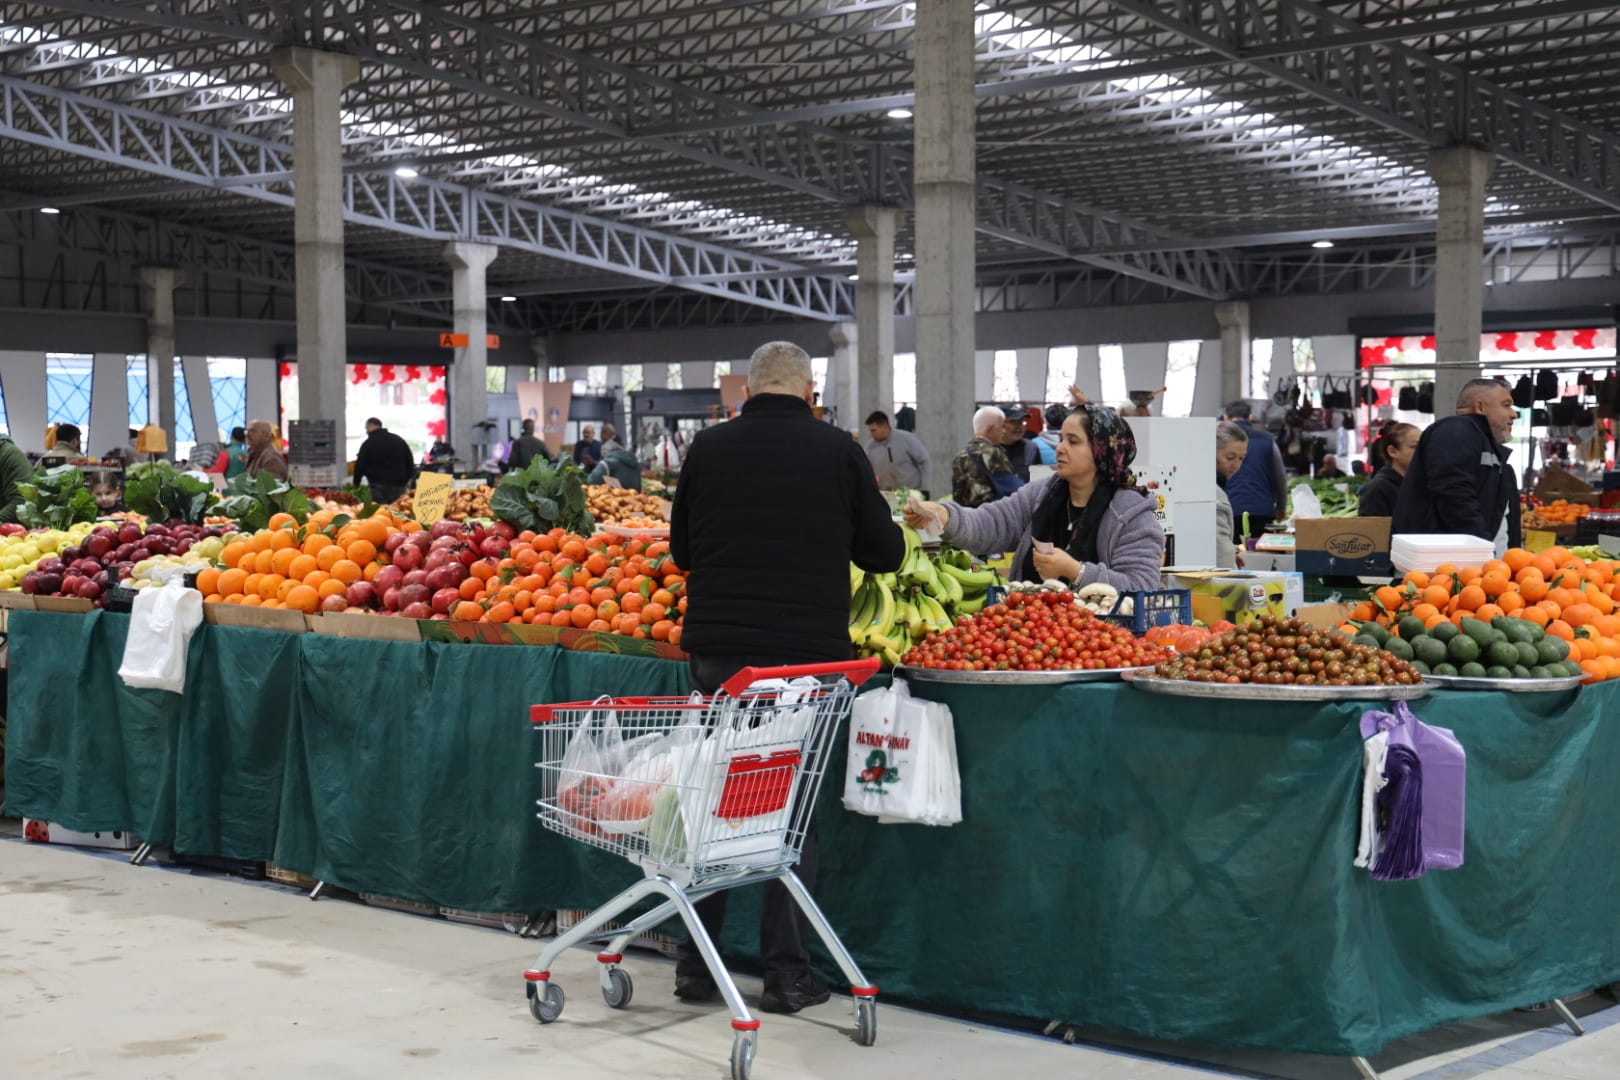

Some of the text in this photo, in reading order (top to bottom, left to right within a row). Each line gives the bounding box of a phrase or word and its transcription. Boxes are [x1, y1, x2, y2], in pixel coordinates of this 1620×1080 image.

[443, 335, 454, 346] A
[1329, 538, 1372, 554] SanLucar
[856, 731, 885, 748] ALTAN
